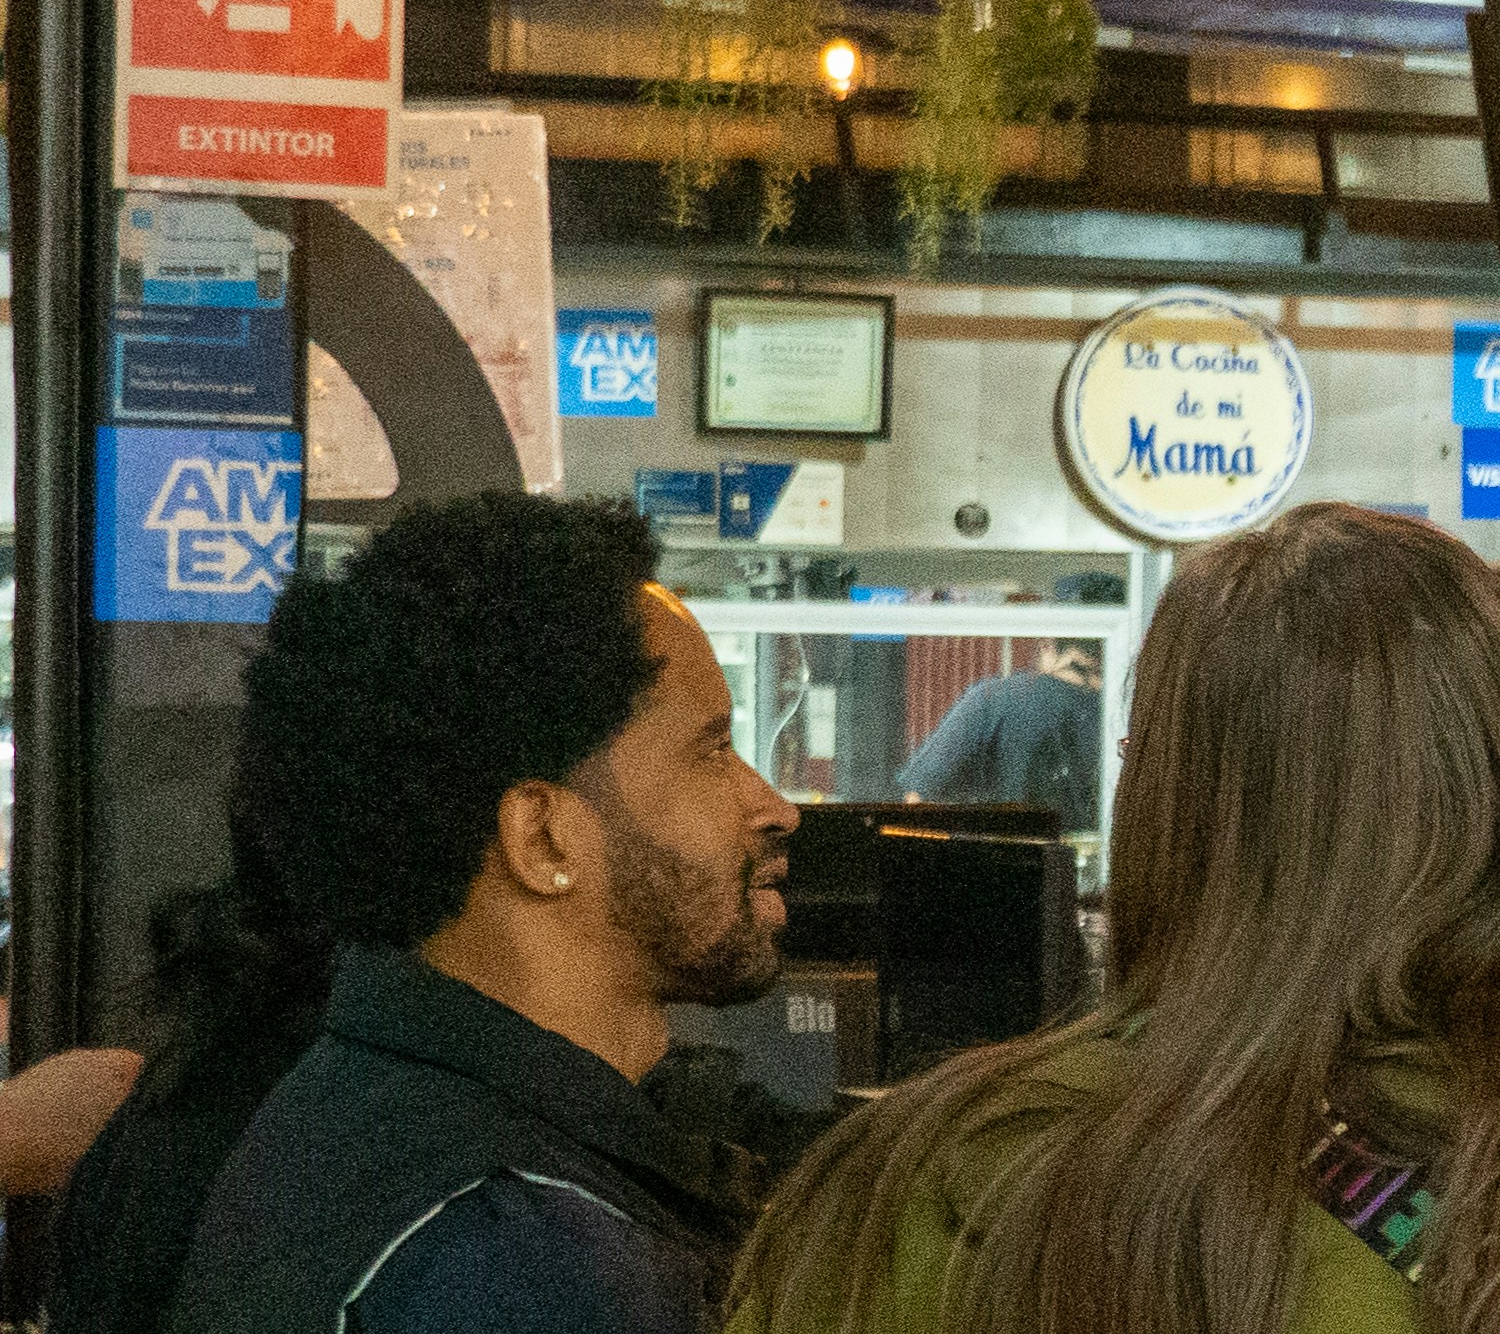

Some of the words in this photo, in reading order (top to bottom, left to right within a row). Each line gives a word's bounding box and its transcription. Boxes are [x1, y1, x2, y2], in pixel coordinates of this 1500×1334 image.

[179, 124, 335, 159] EXTINTOR
[1171, 344, 1259, 373] Cocina
[1176, 389, 1204, 419] de
[1217, 393, 1242, 418] mi
[1114, 415, 1263, 478] Mamá
